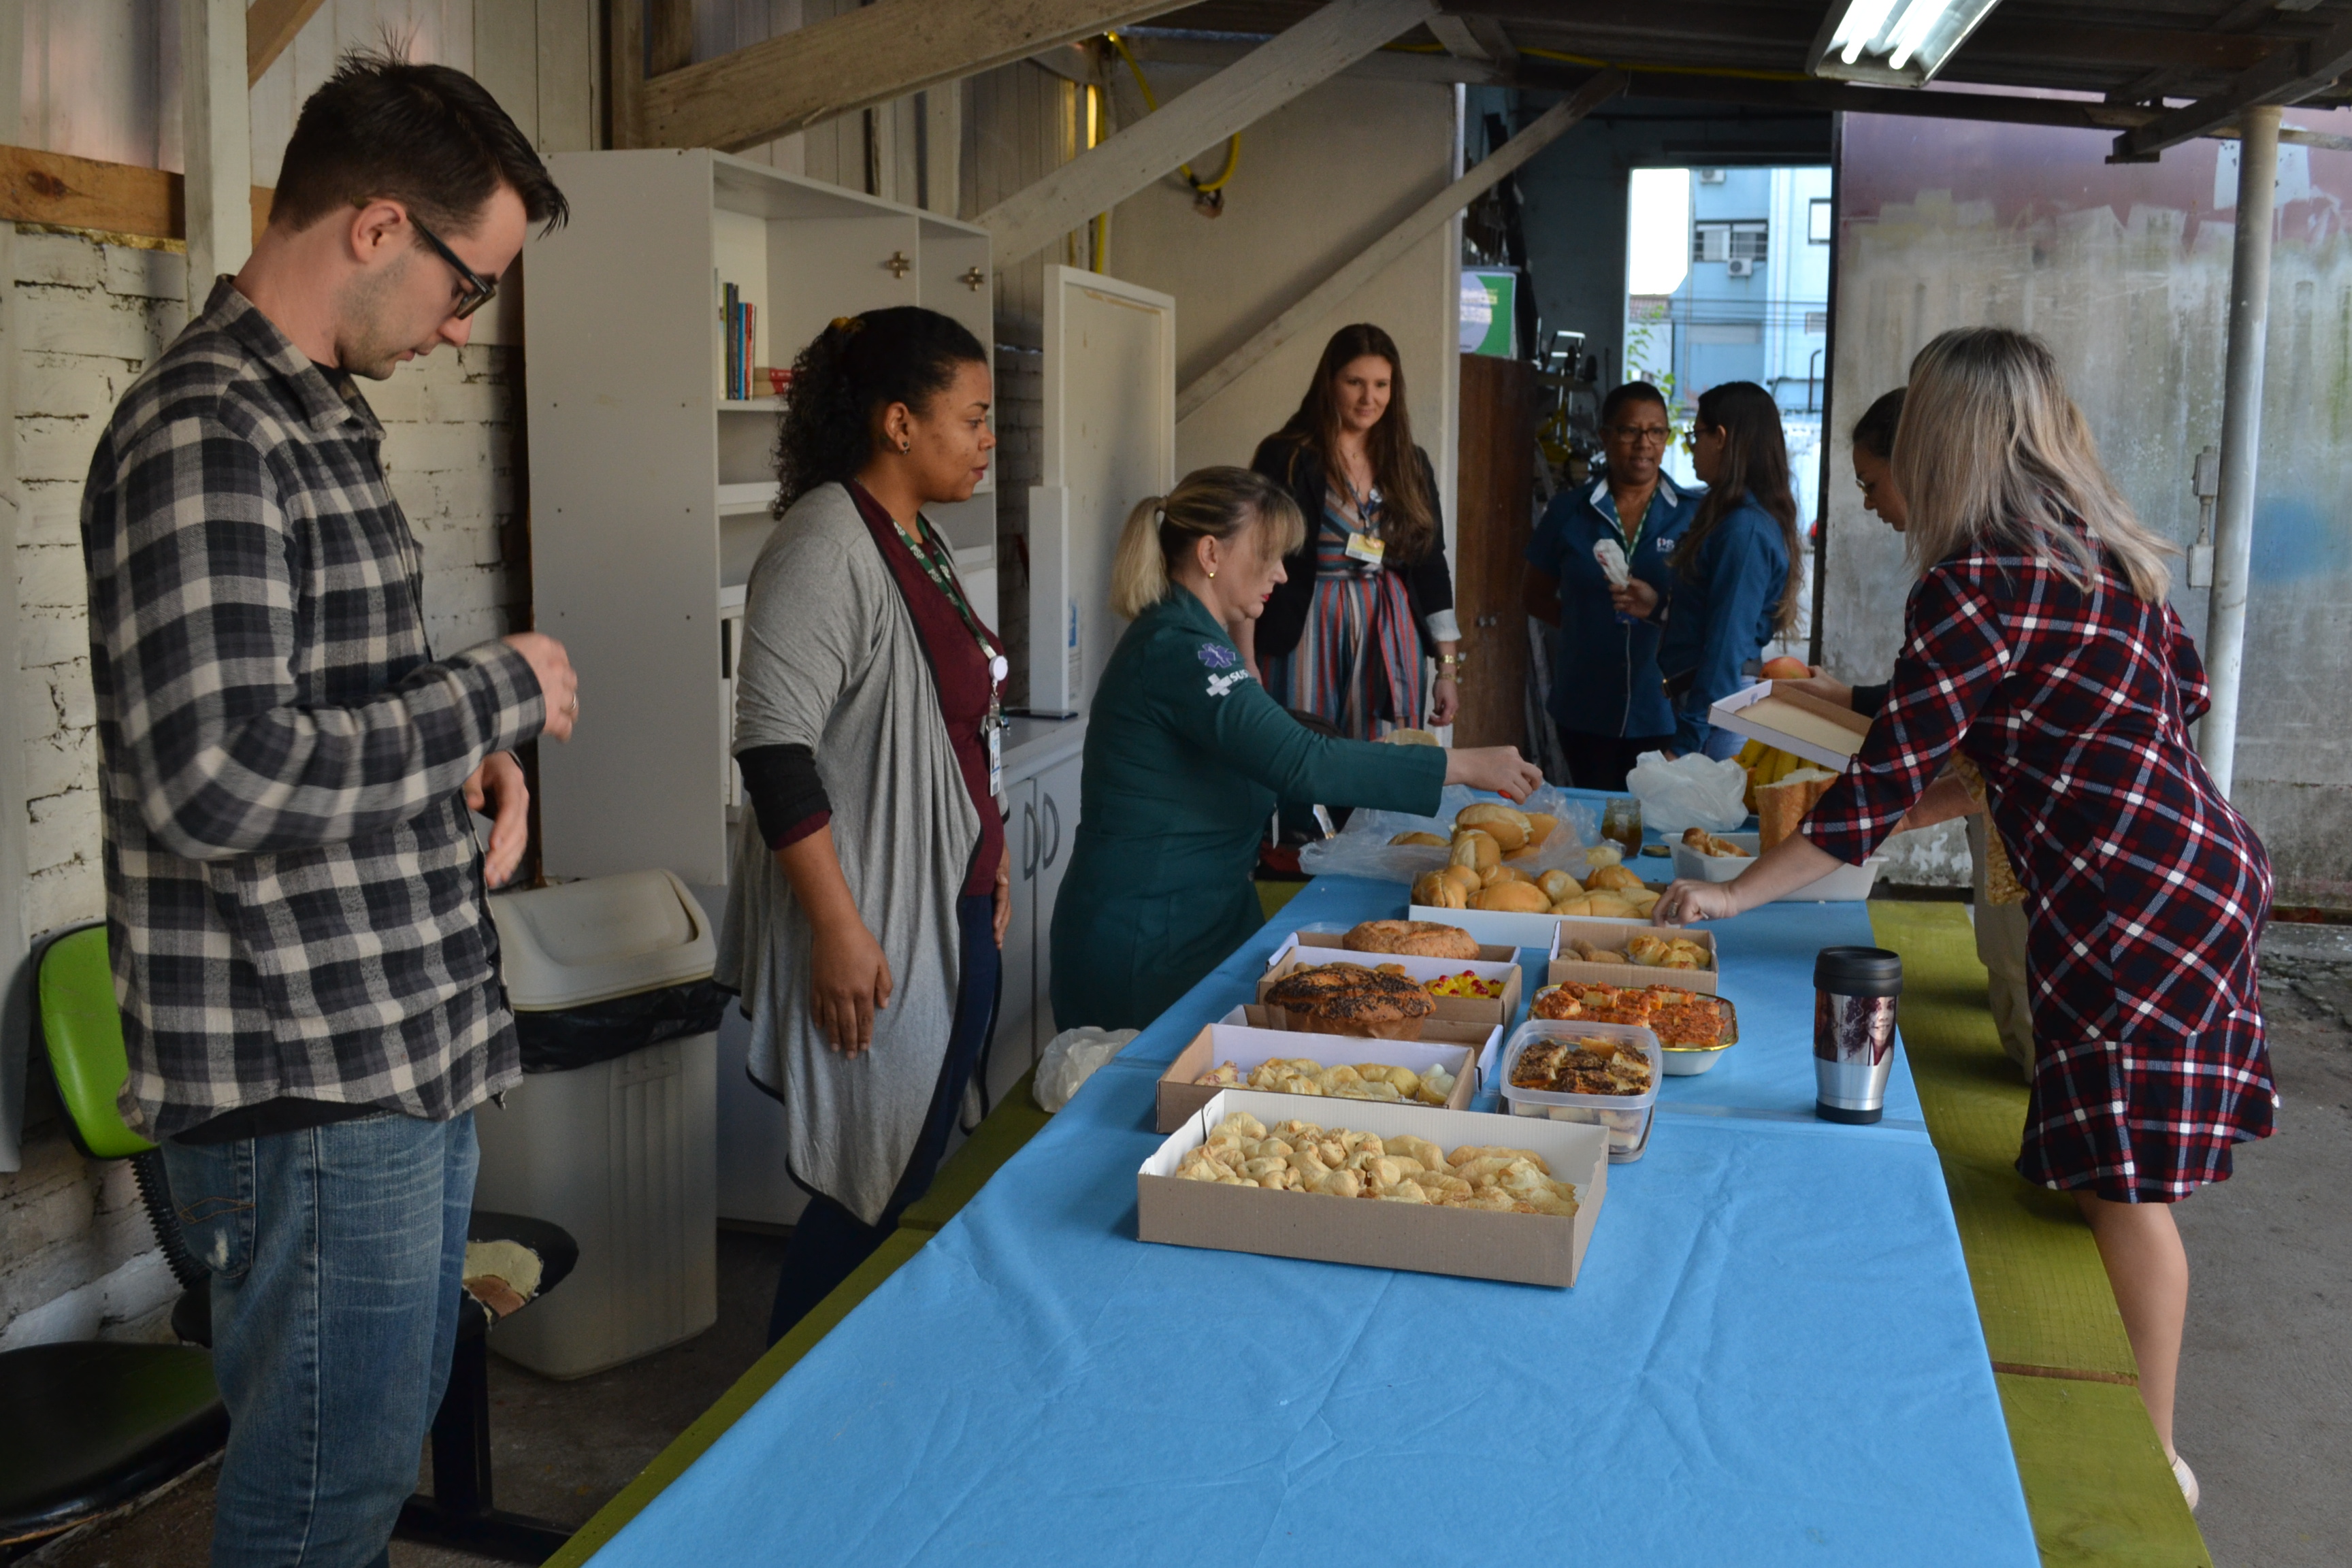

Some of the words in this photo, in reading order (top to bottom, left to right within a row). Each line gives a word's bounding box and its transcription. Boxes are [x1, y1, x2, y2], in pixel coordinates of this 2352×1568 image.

[910, 544, 925, 559] PSP
[928, 568, 942, 583] PSP
[1229, 669, 1250, 682] SUS
